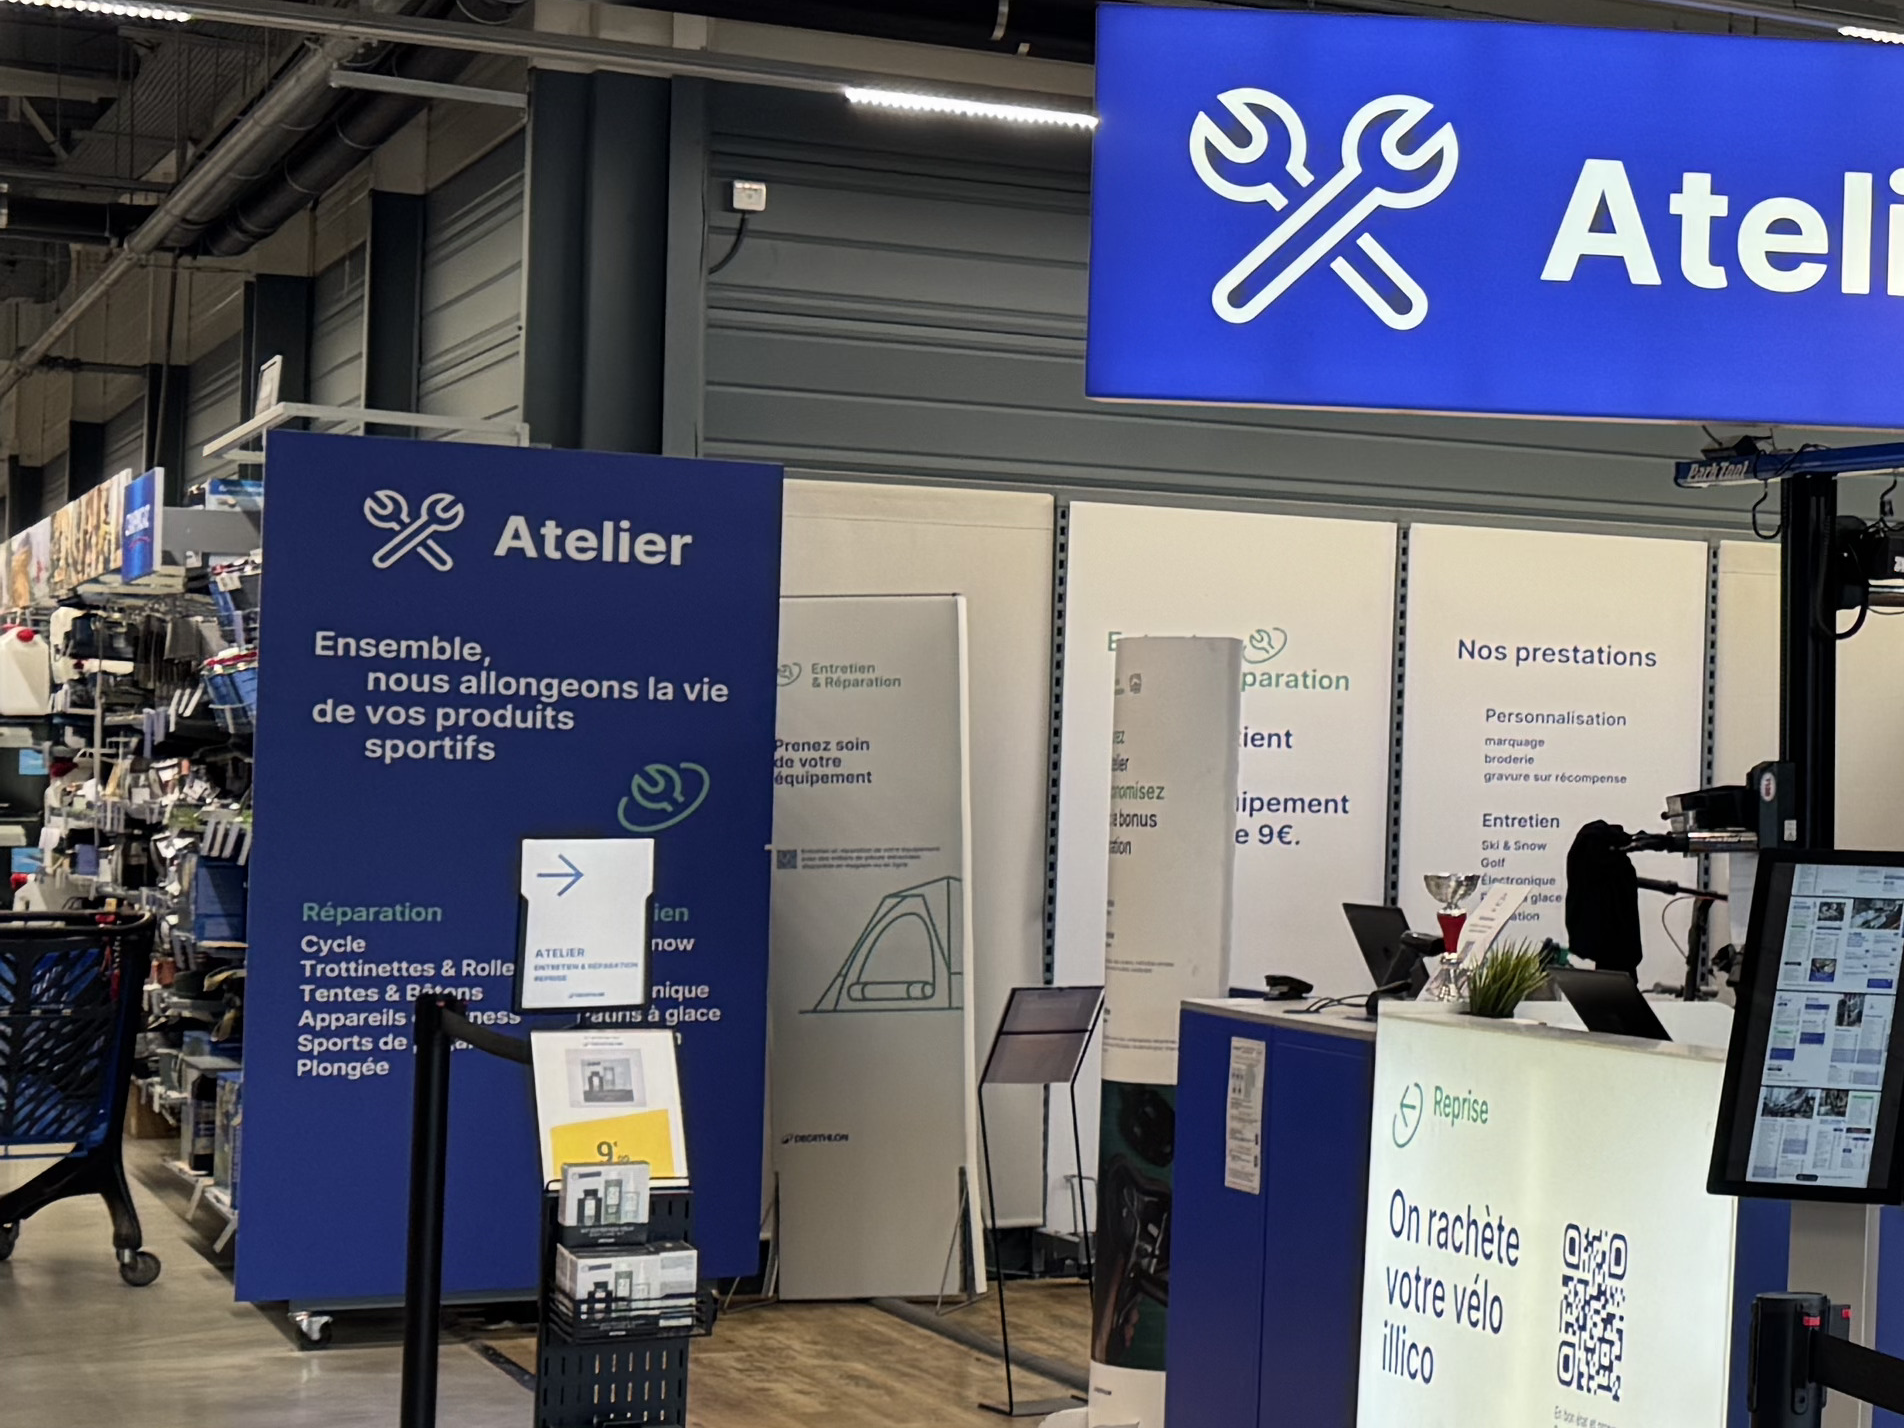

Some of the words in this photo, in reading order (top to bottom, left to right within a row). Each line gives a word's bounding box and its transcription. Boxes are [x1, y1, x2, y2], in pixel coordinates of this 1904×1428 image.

[495, 515, 693, 566] Atelier
[315, 630, 491, 667] Ensemble,
[1458, 639, 1508, 661] Nos
[1515, 642, 1658, 668] prestations
[811, 662, 876, 676] Entretien
[1240, 668, 1350, 692] paration
[367, 670, 450, 694] nous
[459, 670, 639, 703] allongeons
[648, 676, 674, 702] la
[684, 677, 729, 703] vie
[812, 676, 822, 688] &
[825, 673, 902, 690] Réparation
[312, 699, 355, 724] de
[366, 704, 426, 726] vos
[436, 702, 575, 733] produits
[1485, 708, 1627, 727] Personnalisation
[774, 738, 831, 753] Prenez
[836, 738, 870, 752] soin
[1240, 726, 1293, 749] ient
[1485, 737, 1545, 750] marquage
[365, 734, 496, 764] sportifs
[1484, 753, 1535, 765] broderie
[774, 755, 794, 769] de
[799, 756, 842, 769] votre
[773, 770, 873, 786] équipement
[1484, 771, 1530, 785] gravure
[1534, 772, 1552, 783] sur
[1555, 772, 1627, 786] récompense
[1112, 780, 1165, 800] nomisez
[1482, 813, 1560, 829] Entretien
[1235, 828, 1250, 846] e
[1257, 824, 1302, 847] 9€.
[1481, 839, 1500, 852] Ski
[1502, 840, 1512, 852] &
[1513, 840, 1548, 852] Snow
[1481, 857, 1506, 869] Golf
[1530, 891, 1562, 905] glace
[303, 902, 443, 926] Réparation
[655, 902, 689, 923] ien
[1509, 910, 1540, 922] ation
[301, 934, 366, 956] Cycle
[652, 935, 694, 952] now
[535, 948, 585, 959] ATELIER
[301, 959, 436, 978] Trottinettes
[441, 960, 456, 977] &
[461, 959, 515, 977] Rolle
[301, 984, 379, 1003] Tentes
[385, 984, 400, 1001] &
[652, 980, 710, 1002] nique
[298, 1009, 407, 1030] Appareils
[469, 1010, 522, 1025] ness
[648, 1004, 660, 1022] à
[665, 1006, 722, 1026] glace
[298, 1033, 373, 1055] Sports
[379, 1032, 408, 1051] de
[297, 1057, 390, 1081] Plongée
[1433, 1085, 1489, 1128] Reprise
[1389, 1188, 1421, 1243] On
[1427, 1204, 1521, 1270] rachète
[1386, 1264, 1445, 1317] votre
[1453, 1271, 1504, 1336] vélo
[1381, 1318, 1435, 1386] illico
